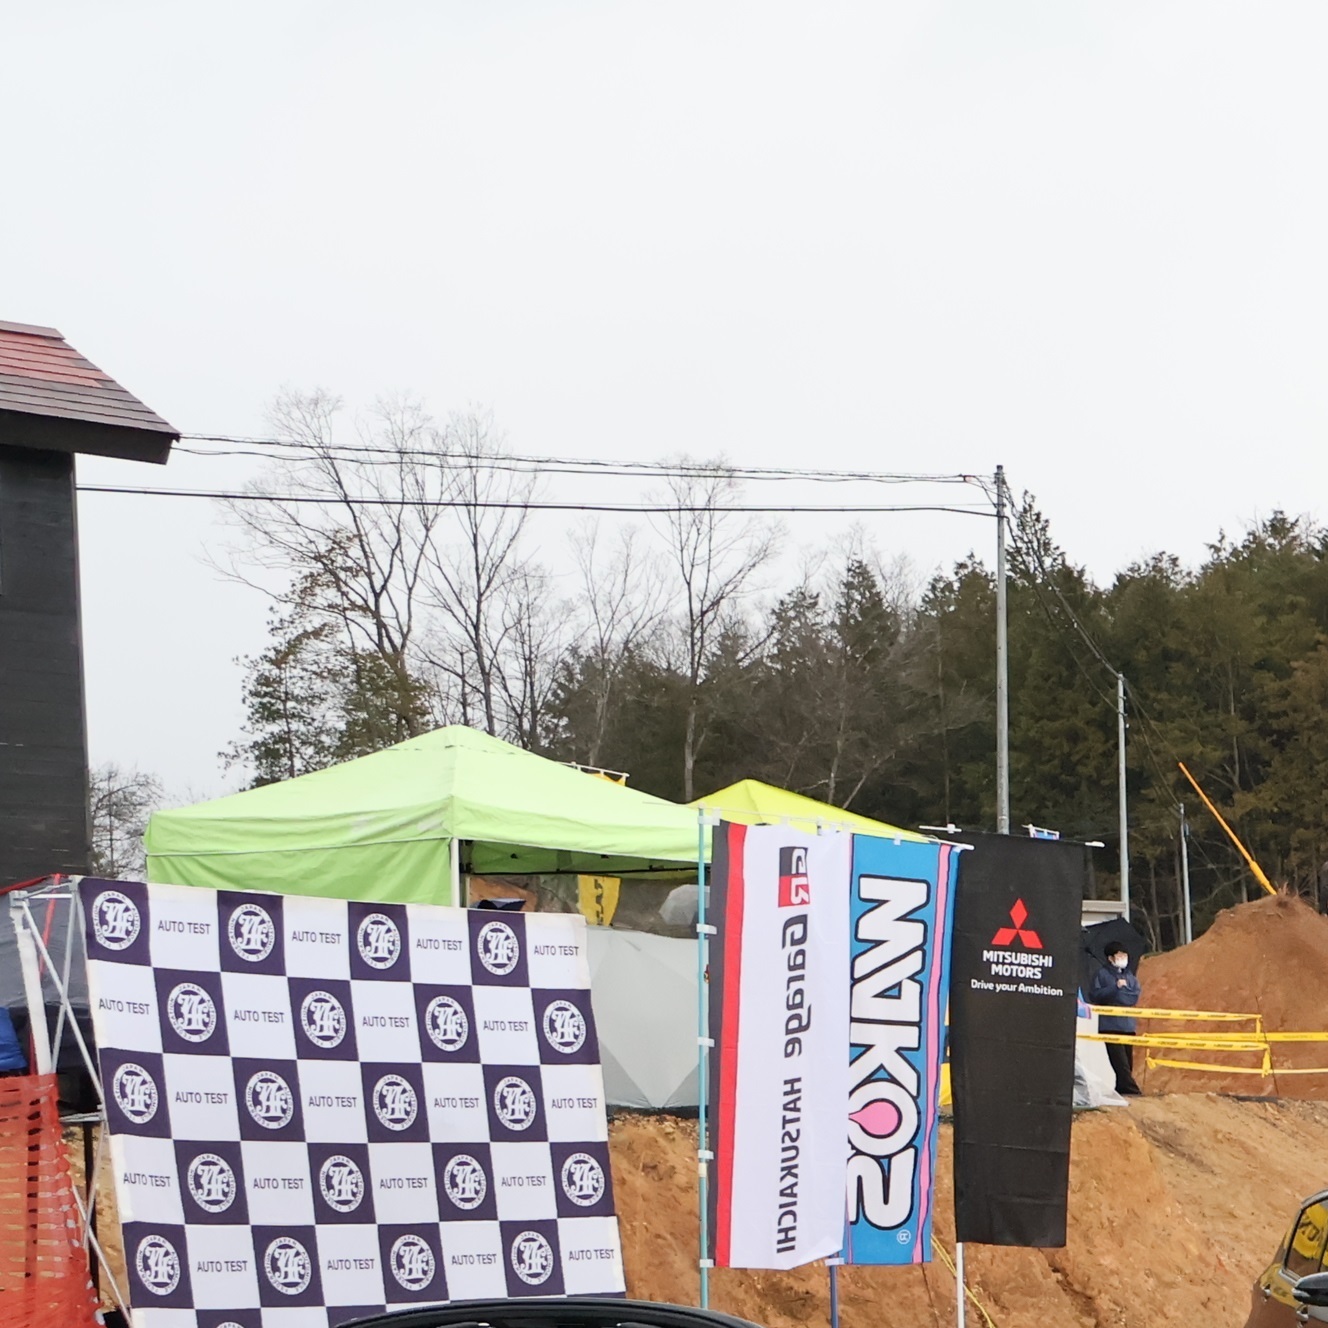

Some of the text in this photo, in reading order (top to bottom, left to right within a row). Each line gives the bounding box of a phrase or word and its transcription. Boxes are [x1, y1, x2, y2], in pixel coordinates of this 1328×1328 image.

[158, 920, 210, 934] AUTO TEST
[292, 931, 341, 944] AUTO TEST
[417, 939, 462, 950] AUTO TEST
[534, 945, 579, 956] AUTO TEST
[982, 950, 1053, 967] MITSUBISHI
[991, 964, 1042, 979] MOTORS
[971, 979, 1063, 996] Drive your Ambition
[99, 999, 149, 1014] AUTO TEST
[234, 1010, 284, 1023] AUTO TEST
[363, 1016, 409, 1028] AUTO TEST
[484, 1021, 528, 1031] AUTO TEST
[176, 1092, 228, 1104] AUTO TEST
[309, 1096, 357, 1107] AUTO TEST
[434, 1098, 479, 1108] AUTO TEST
[552, 1098, 597, 1109] AUTO TEST
[124, 1173, 170, 1187] AUTO TEST
[253, 1178, 304, 1189] AUTO TEST
[380, 1178, 427, 1189] AUTO TEST
[502, 1176, 546, 1186] AUTO TEST
[452, 1254, 496, 1265] AUTO TEST
[569, 1249, 614, 1260] AUTO TEST
[197, 1260, 247, 1272] AUTO TEST
[327, 1259, 374, 1270] AUTO TEST
